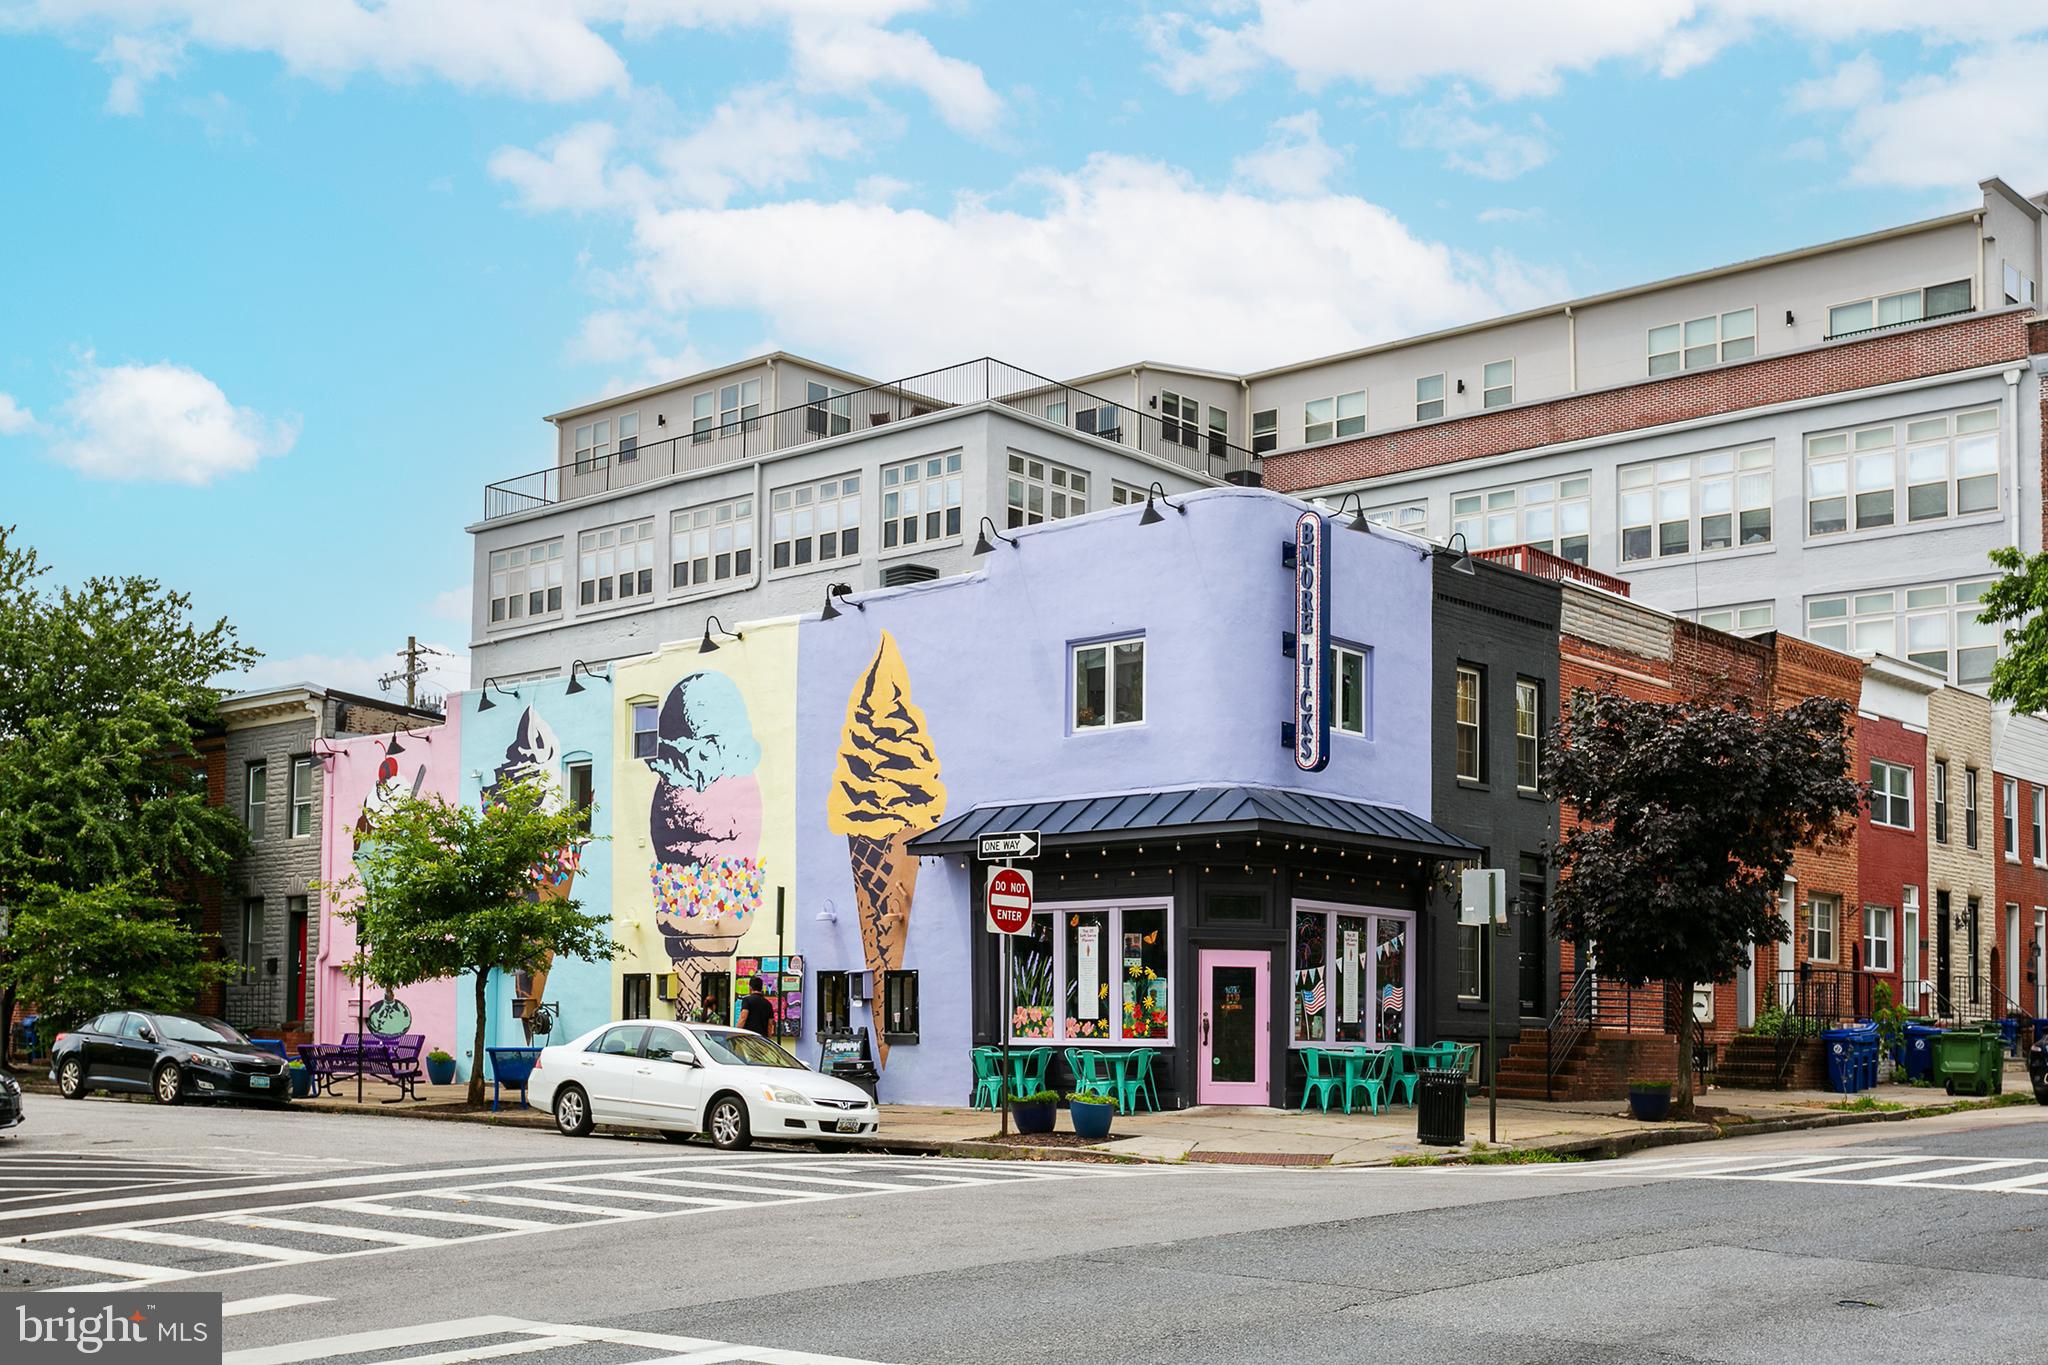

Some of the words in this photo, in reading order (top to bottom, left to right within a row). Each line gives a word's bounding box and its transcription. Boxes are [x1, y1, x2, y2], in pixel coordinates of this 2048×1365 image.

[1300, 522, 1315, 636] BMORE
[1299, 643, 1314, 760] LICKS
[984, 841, 1000, 852] ONE
[1003, 840, 1020, 851] WAY
[995, 881, 1006, 892] DO
[1010, 882, 1025, 894] NOT
[997, 909, 1022, 921] ENTER
